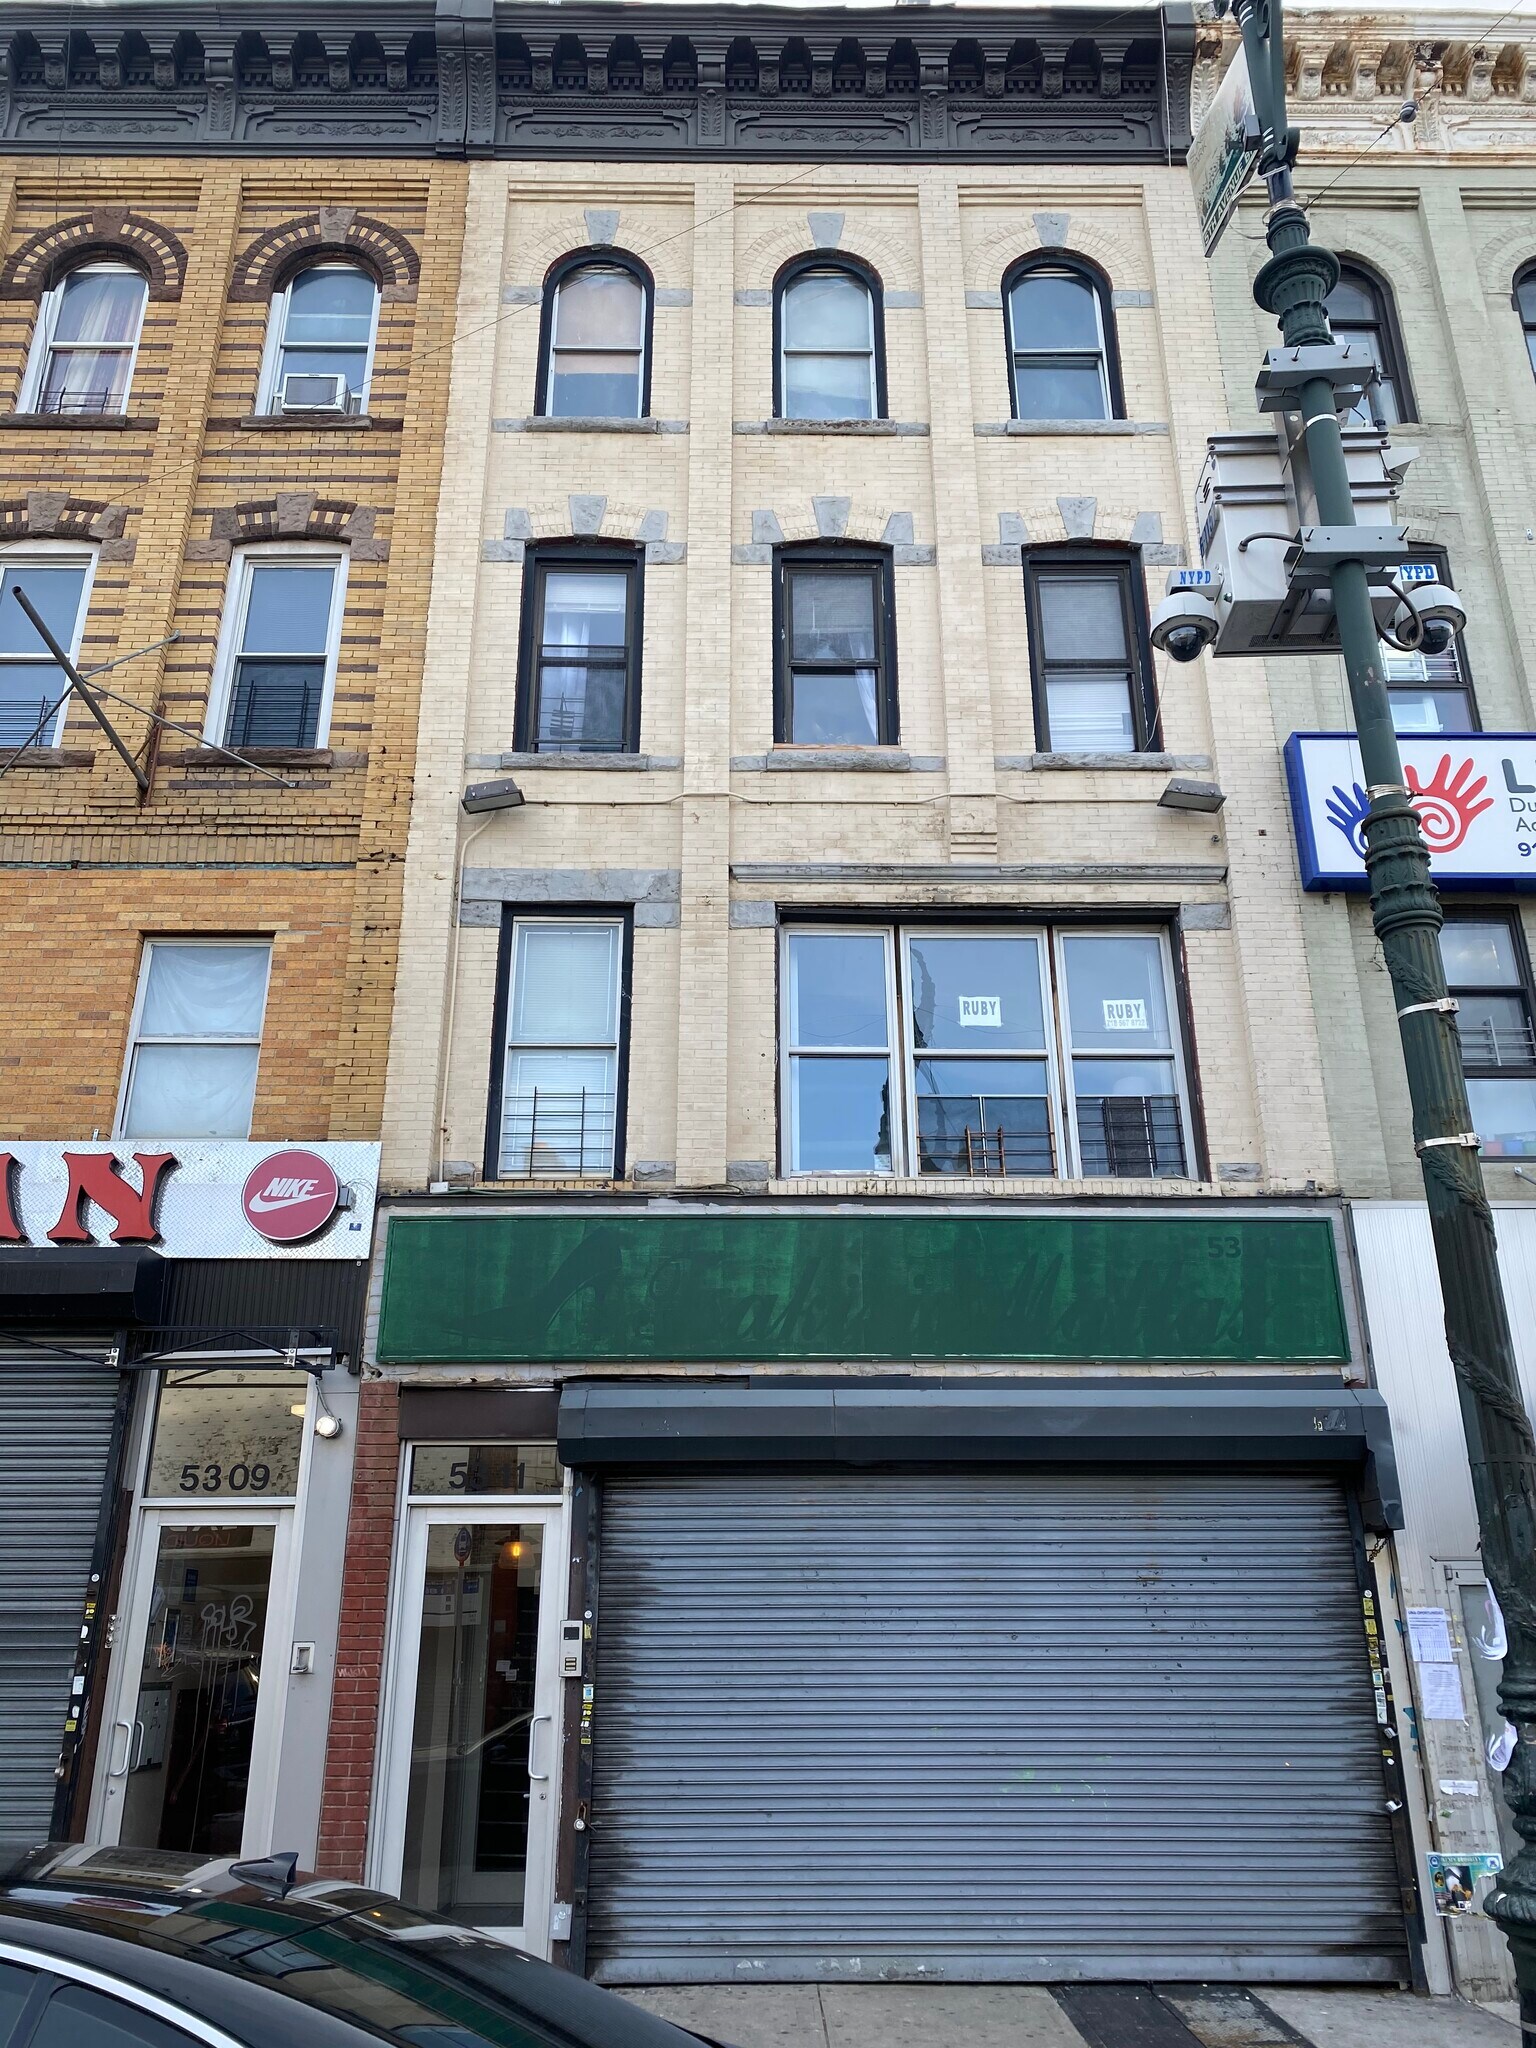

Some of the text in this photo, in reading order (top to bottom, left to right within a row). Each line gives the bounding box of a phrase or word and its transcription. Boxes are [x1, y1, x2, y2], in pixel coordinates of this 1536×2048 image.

[1203, 214, 1217, 247] 5TH
[1216, 161, 1244, 219] AVENUE
[1180, 570, 1211, 585] NYPD
[1501, 758, 1536, 794] L
[963, 1000, 996, 1016] RUBY
[1107, 1003, 1141, 1019] RUBY
[263, 1177, 320, 1198] NIKE
